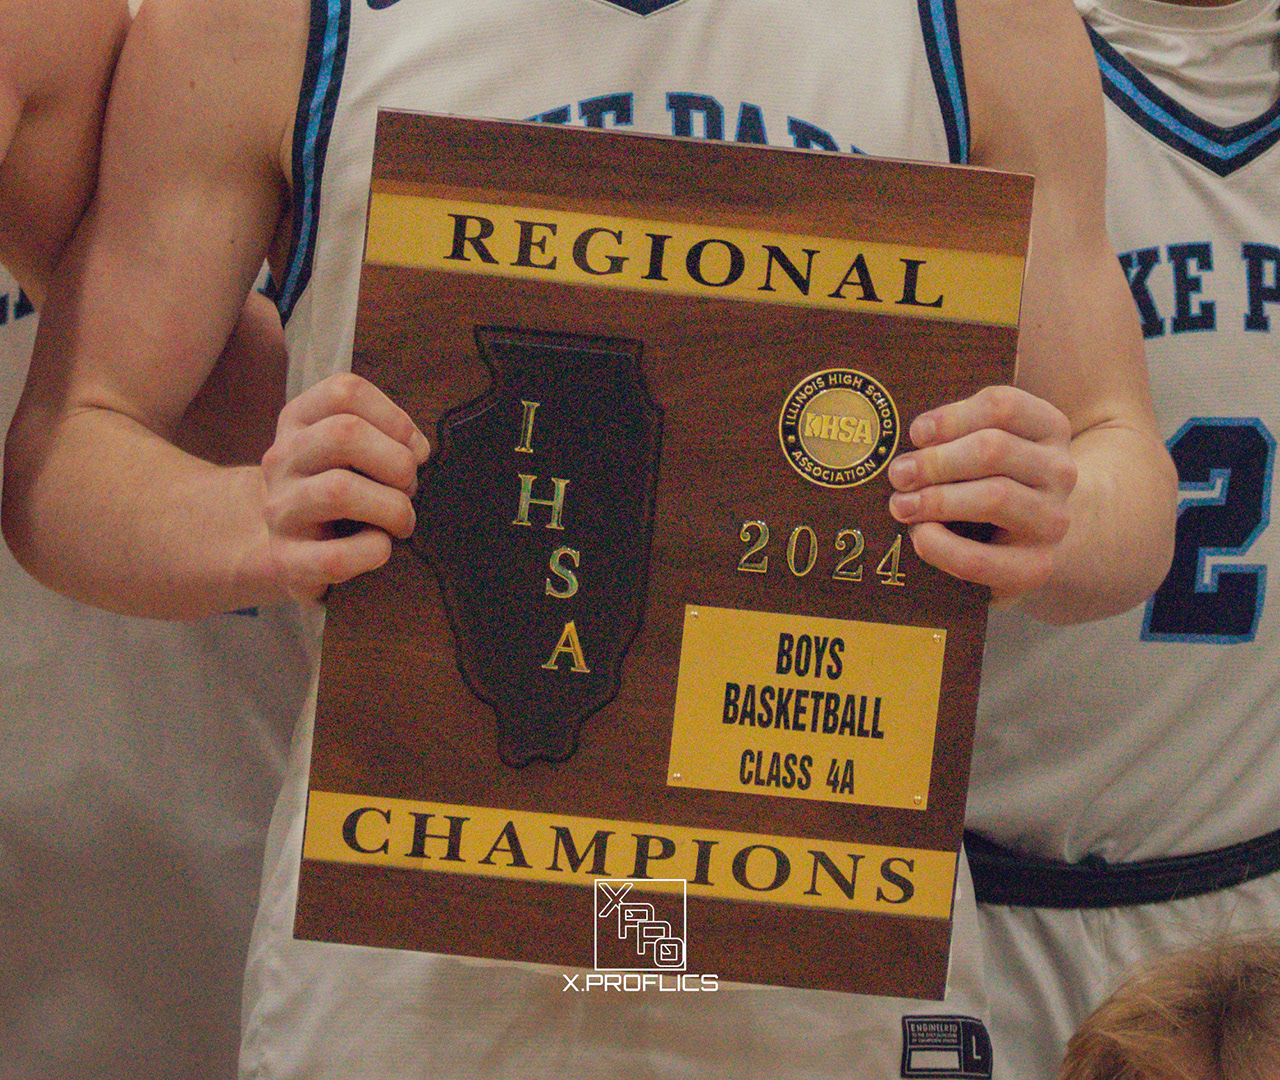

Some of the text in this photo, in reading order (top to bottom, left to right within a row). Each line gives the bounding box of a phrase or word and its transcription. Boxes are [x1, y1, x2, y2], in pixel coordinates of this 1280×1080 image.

[444, 212, 946, 309] REGIONAL
[786, 373, 893, 437] ILLINOIS HIGH SCHOOL
[791, 450, 877, 482] ASSOCIATION
[737, 520, 908, 587] 2024
[1139, 417, 1278, 644] 2
[775, 631, 845, 682] BOYS
[721, 682, 886, 740] BASKETBALL
[738, 748, 856, 796] CLASS 4A
[341, 806, 917, 906] CHAMPIONS
[972, 1035, 981, 1059] L
